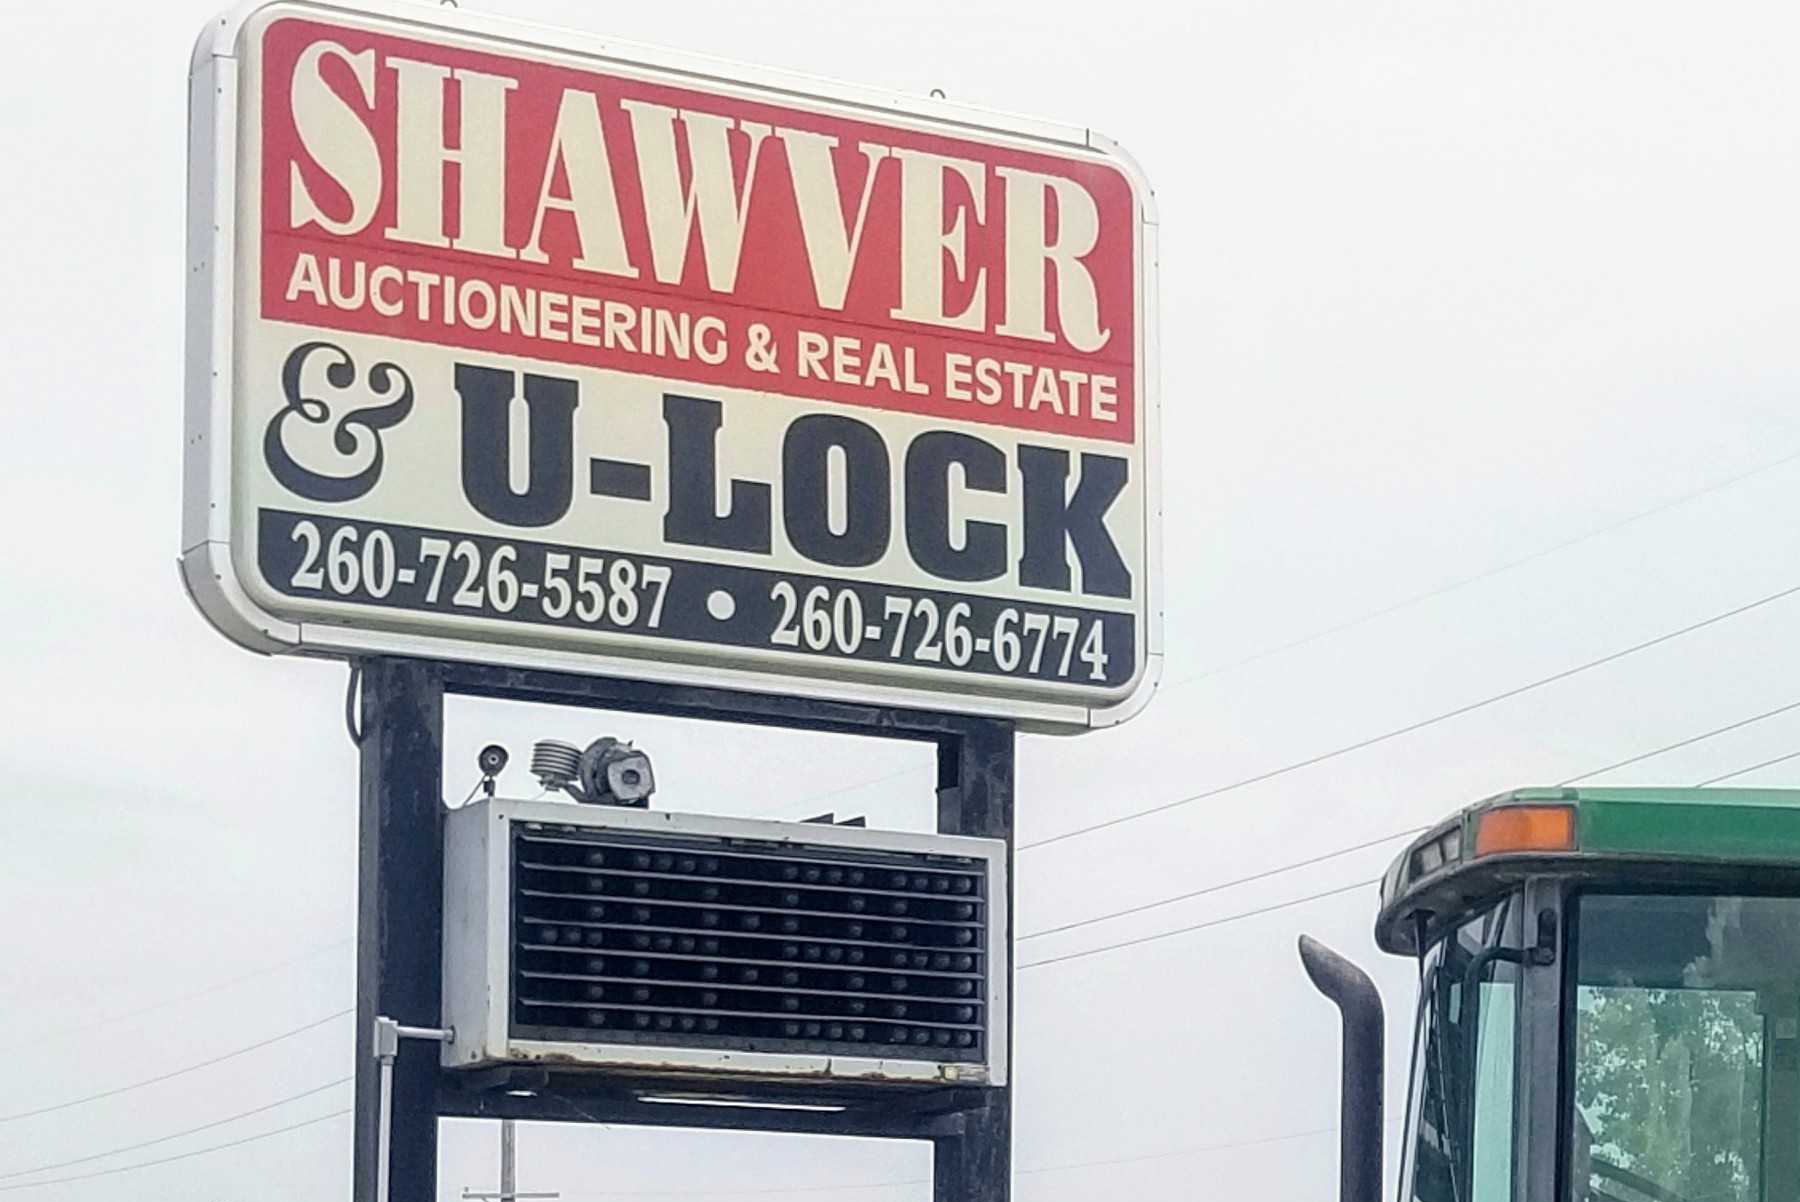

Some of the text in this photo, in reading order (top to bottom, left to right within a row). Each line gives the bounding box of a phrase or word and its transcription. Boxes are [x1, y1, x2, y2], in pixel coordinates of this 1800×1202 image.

[290, 40, 1110, 351] SHAWVER
[285, 253, 1118, 423] AUCTIONEERING & REAL ESTATE
[263, 341, 1133, 600] & U-LOCK
[291, 522, 1109, 682] 260-726-5587 260-726-6774
